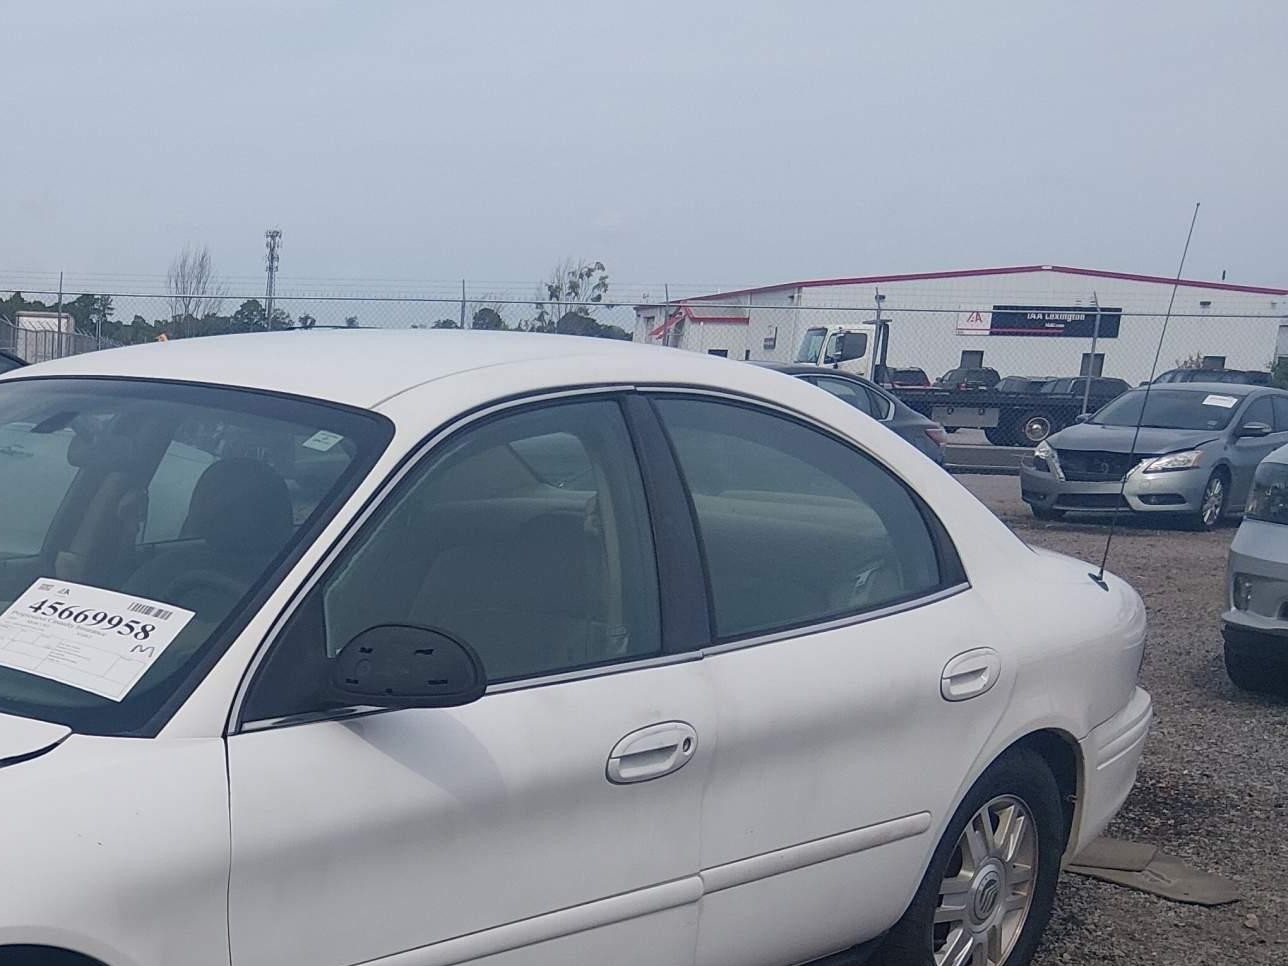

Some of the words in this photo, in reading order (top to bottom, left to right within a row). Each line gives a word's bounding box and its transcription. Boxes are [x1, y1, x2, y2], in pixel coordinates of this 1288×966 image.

[1027, 312, 1043, 320] IAA
[1045, 312, 1085, 322] Lexington
[29, 599, 156, 640] 45669958
